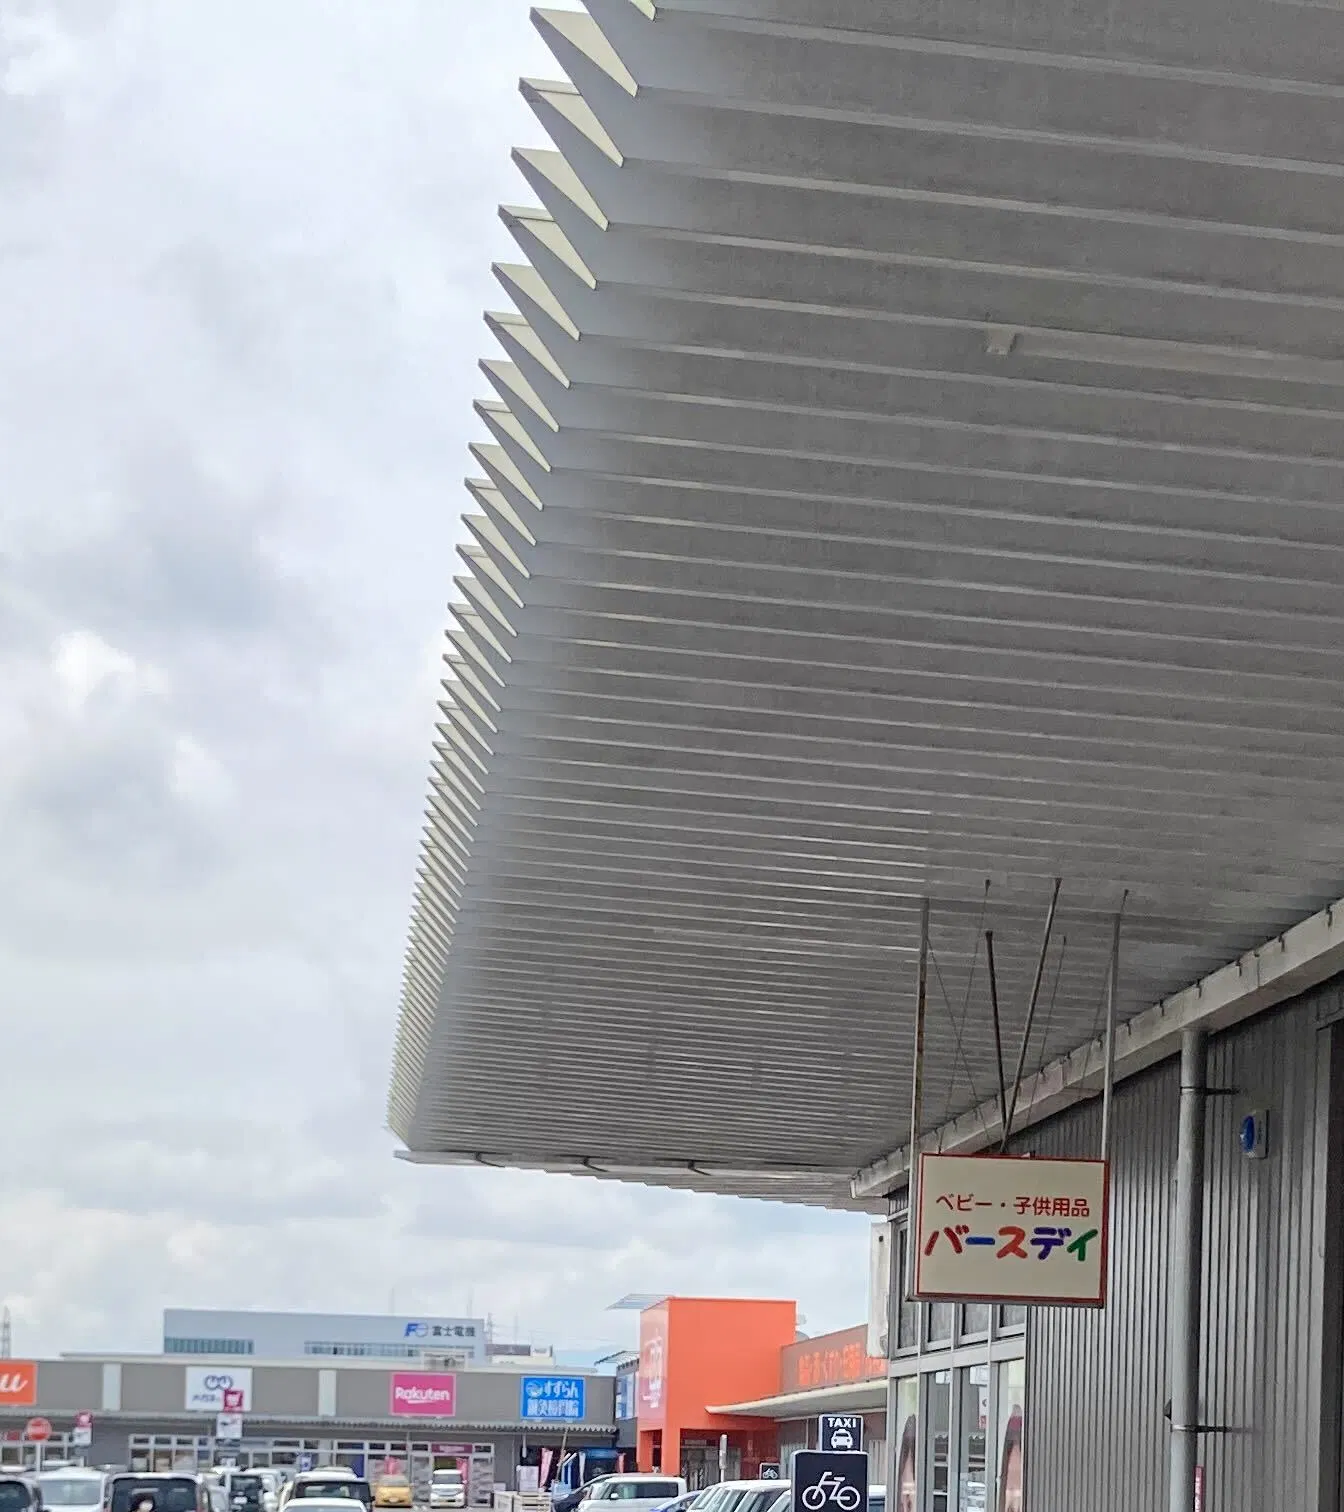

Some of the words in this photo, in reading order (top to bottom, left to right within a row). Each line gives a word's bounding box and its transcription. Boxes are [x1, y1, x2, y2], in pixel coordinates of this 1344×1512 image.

[936, 1193, 1090, 1217] ベビー・子供用品
[924, 1225, 1098, 1262] バースデイ
[432, 1325, 476, 1337] 富士電機
[395, 1386, 450, 1403] Rakuten
[827, 1417, 857, 1428] TAXI
